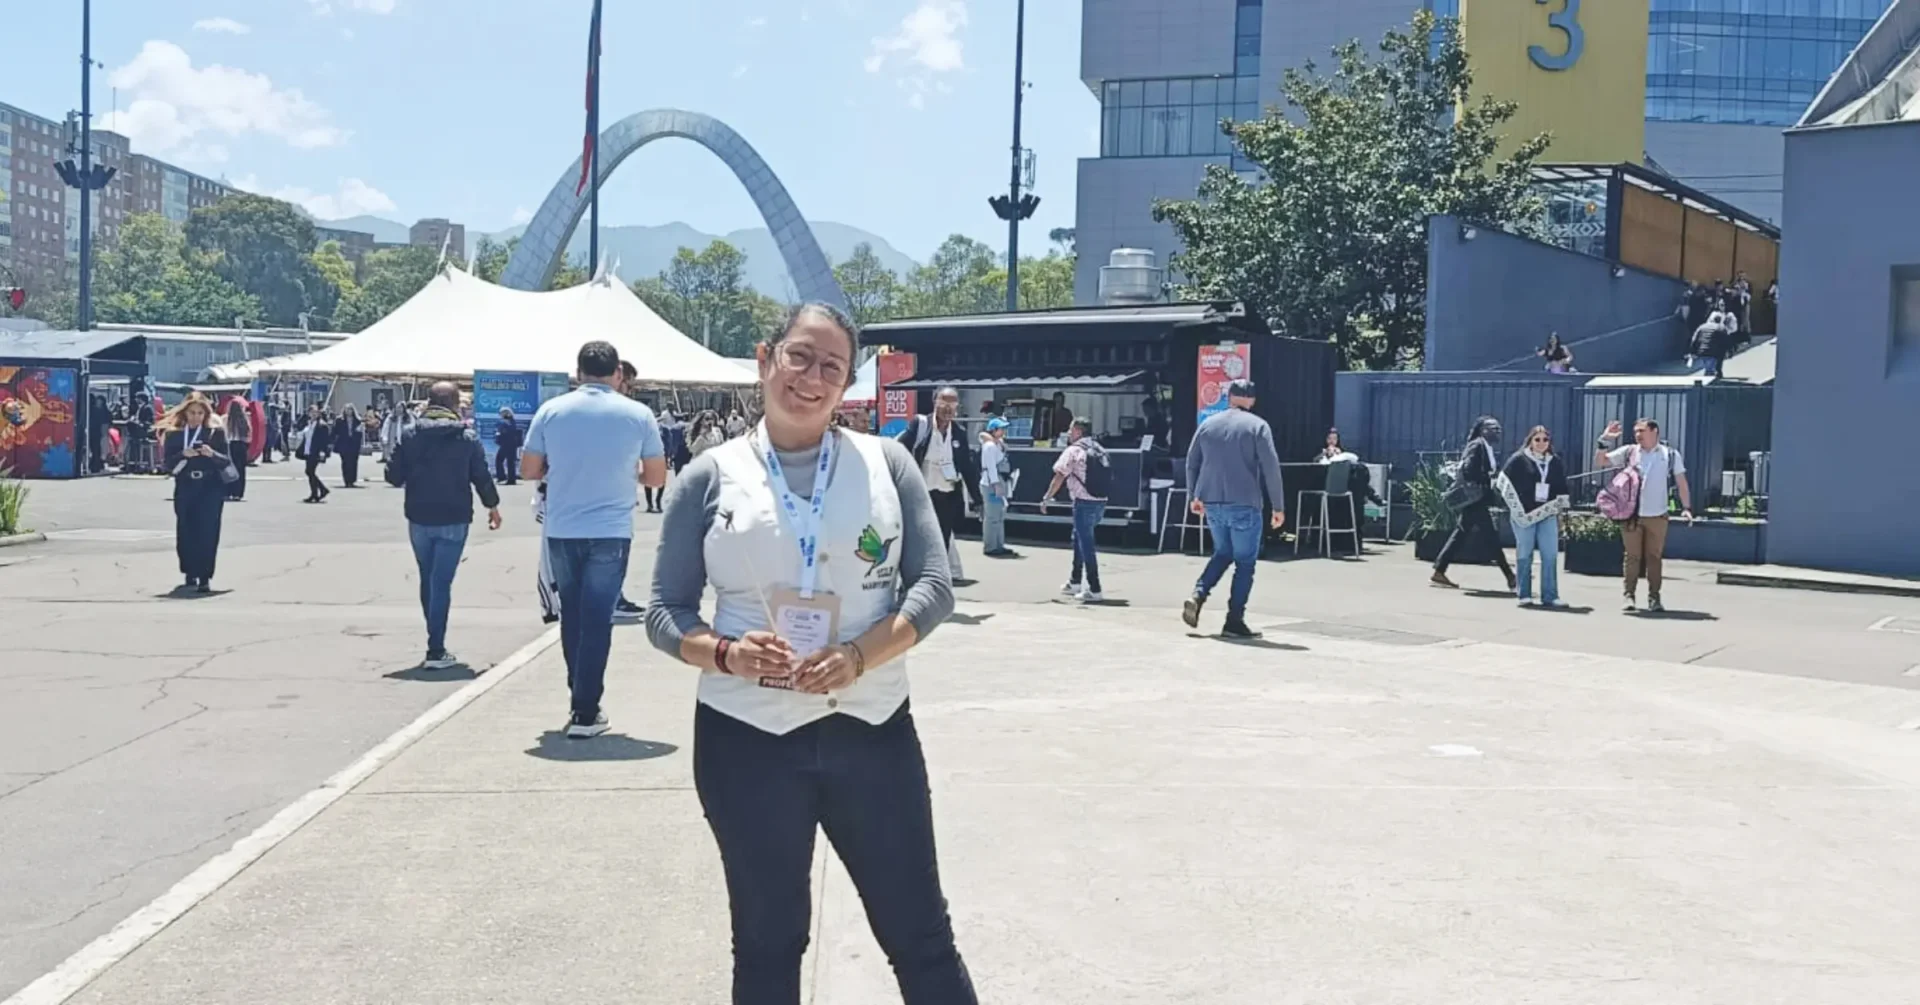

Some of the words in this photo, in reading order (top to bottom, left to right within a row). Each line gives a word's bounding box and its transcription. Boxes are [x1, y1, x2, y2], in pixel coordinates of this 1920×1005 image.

[1526, 0, 1585, 71] 3
[885, 390, 907, 401] GUD
[885, 402, 907, 413] FUD
